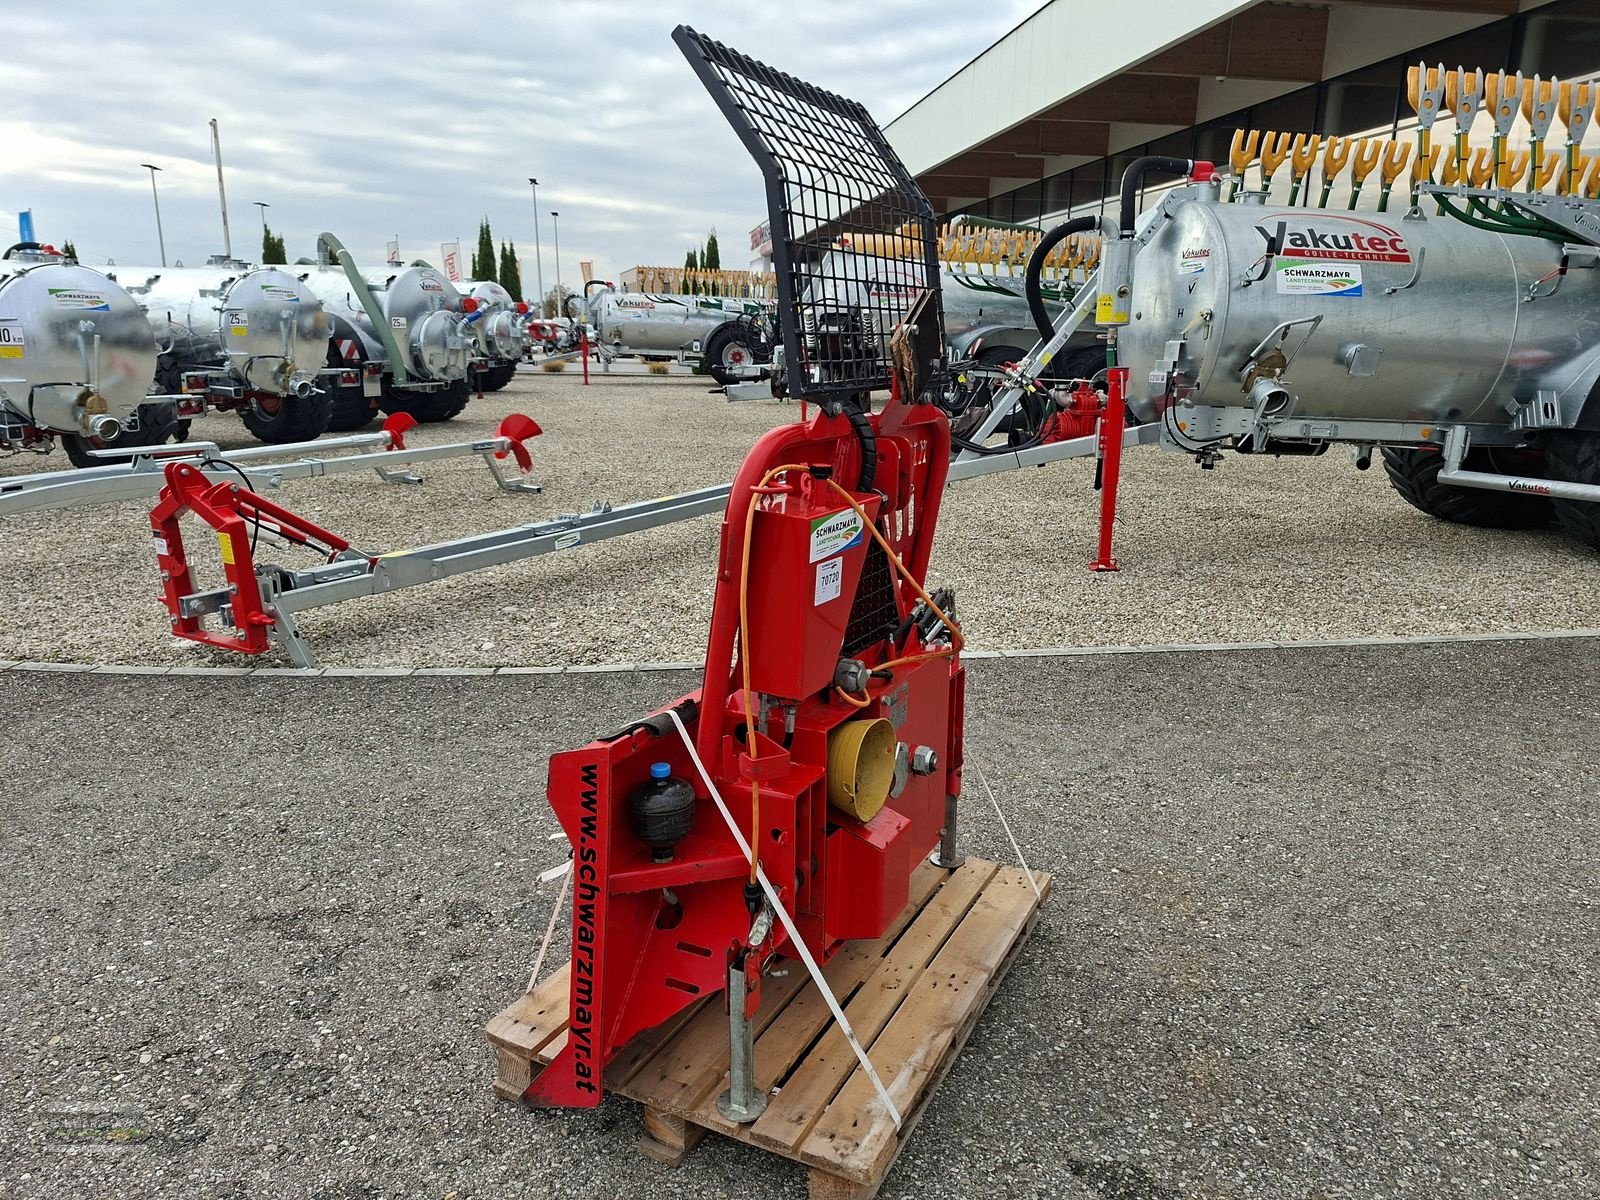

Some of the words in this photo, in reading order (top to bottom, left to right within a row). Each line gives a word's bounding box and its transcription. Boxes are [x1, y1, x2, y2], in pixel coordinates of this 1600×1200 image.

[1254, 221, 1409, 256] Vakutec
[1182, 248, 1211, 259] Vakutec
[1284, 268, 1351, 278] SCHWARZMAYR
[615, 298, 655, 308] Vakutec
[229, 313, 240, 324] 25
[1177, 308, 1185, 318] H
[12, 335, 23, 343] km
[1508, 479, 1550, 493] Vakutec
[816, 517, 857, 538] SCHWARZMAYR
[821, 571, 839, 587] 70720
[567, 763, 601, 1094] www.schwarzmayr.at
